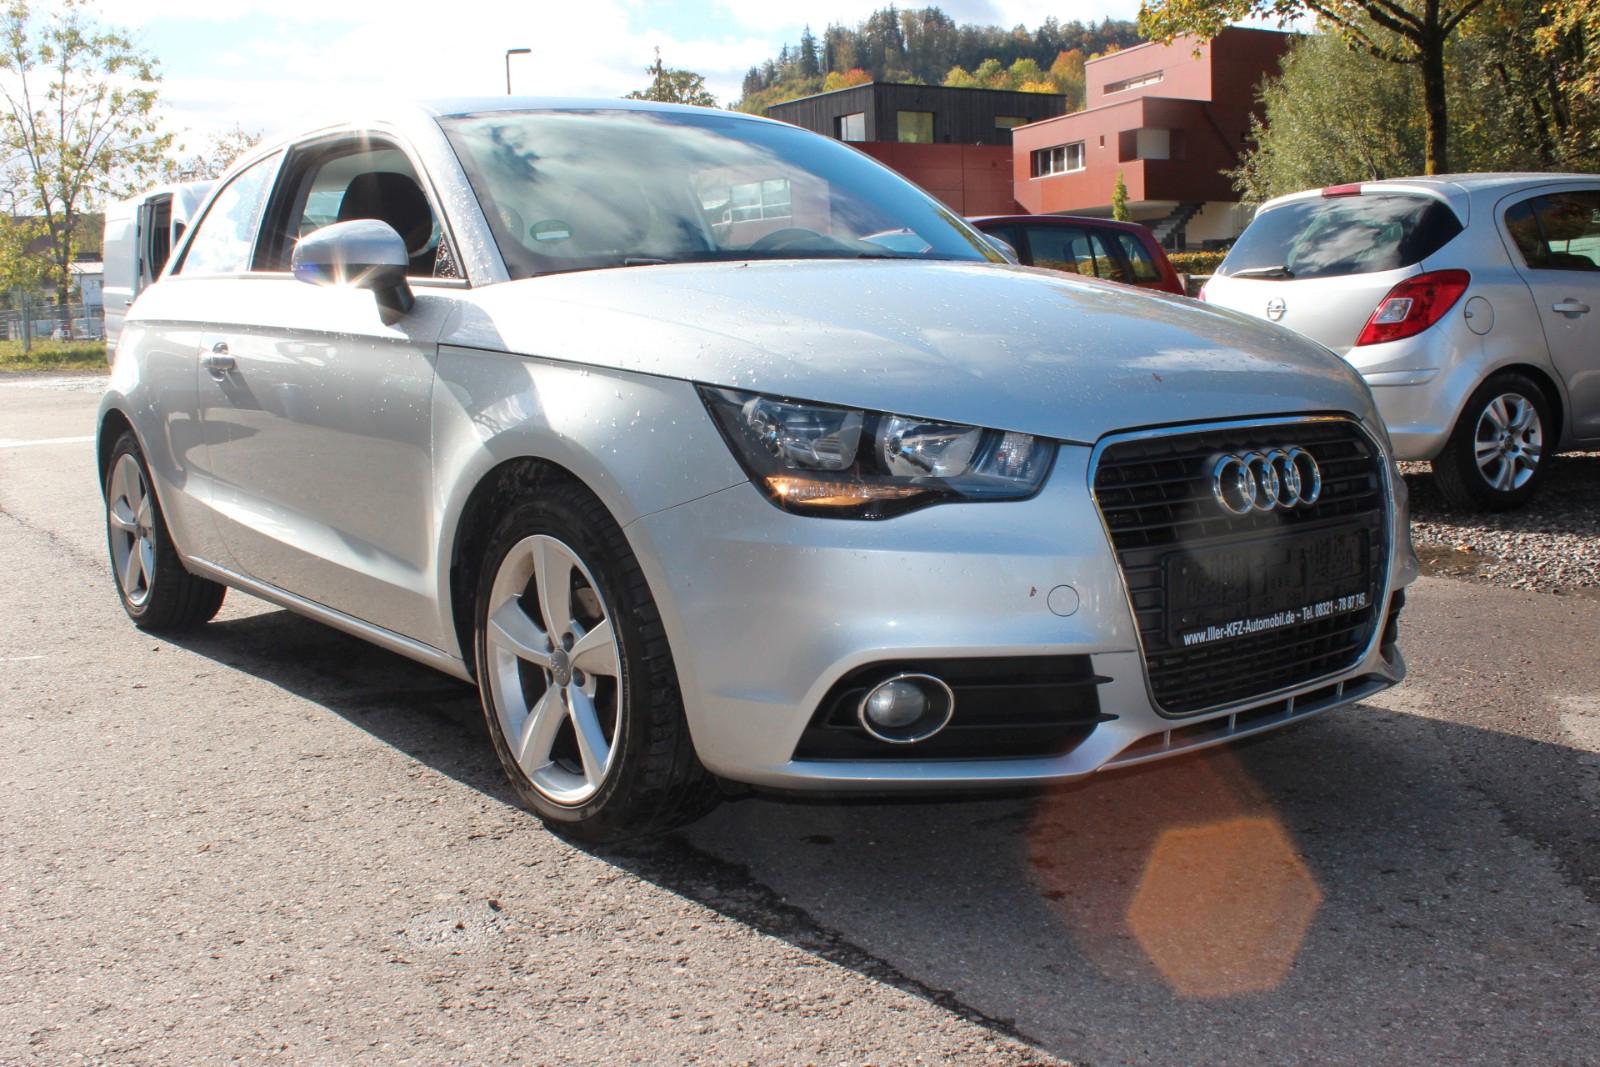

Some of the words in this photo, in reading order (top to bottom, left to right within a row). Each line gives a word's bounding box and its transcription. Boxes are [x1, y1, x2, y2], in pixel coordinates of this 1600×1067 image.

[1302, 606, 1314, 620] Tel.
[1315, 600, 1333, 617] 08321
[1338, 597, 1346, 611] 78
